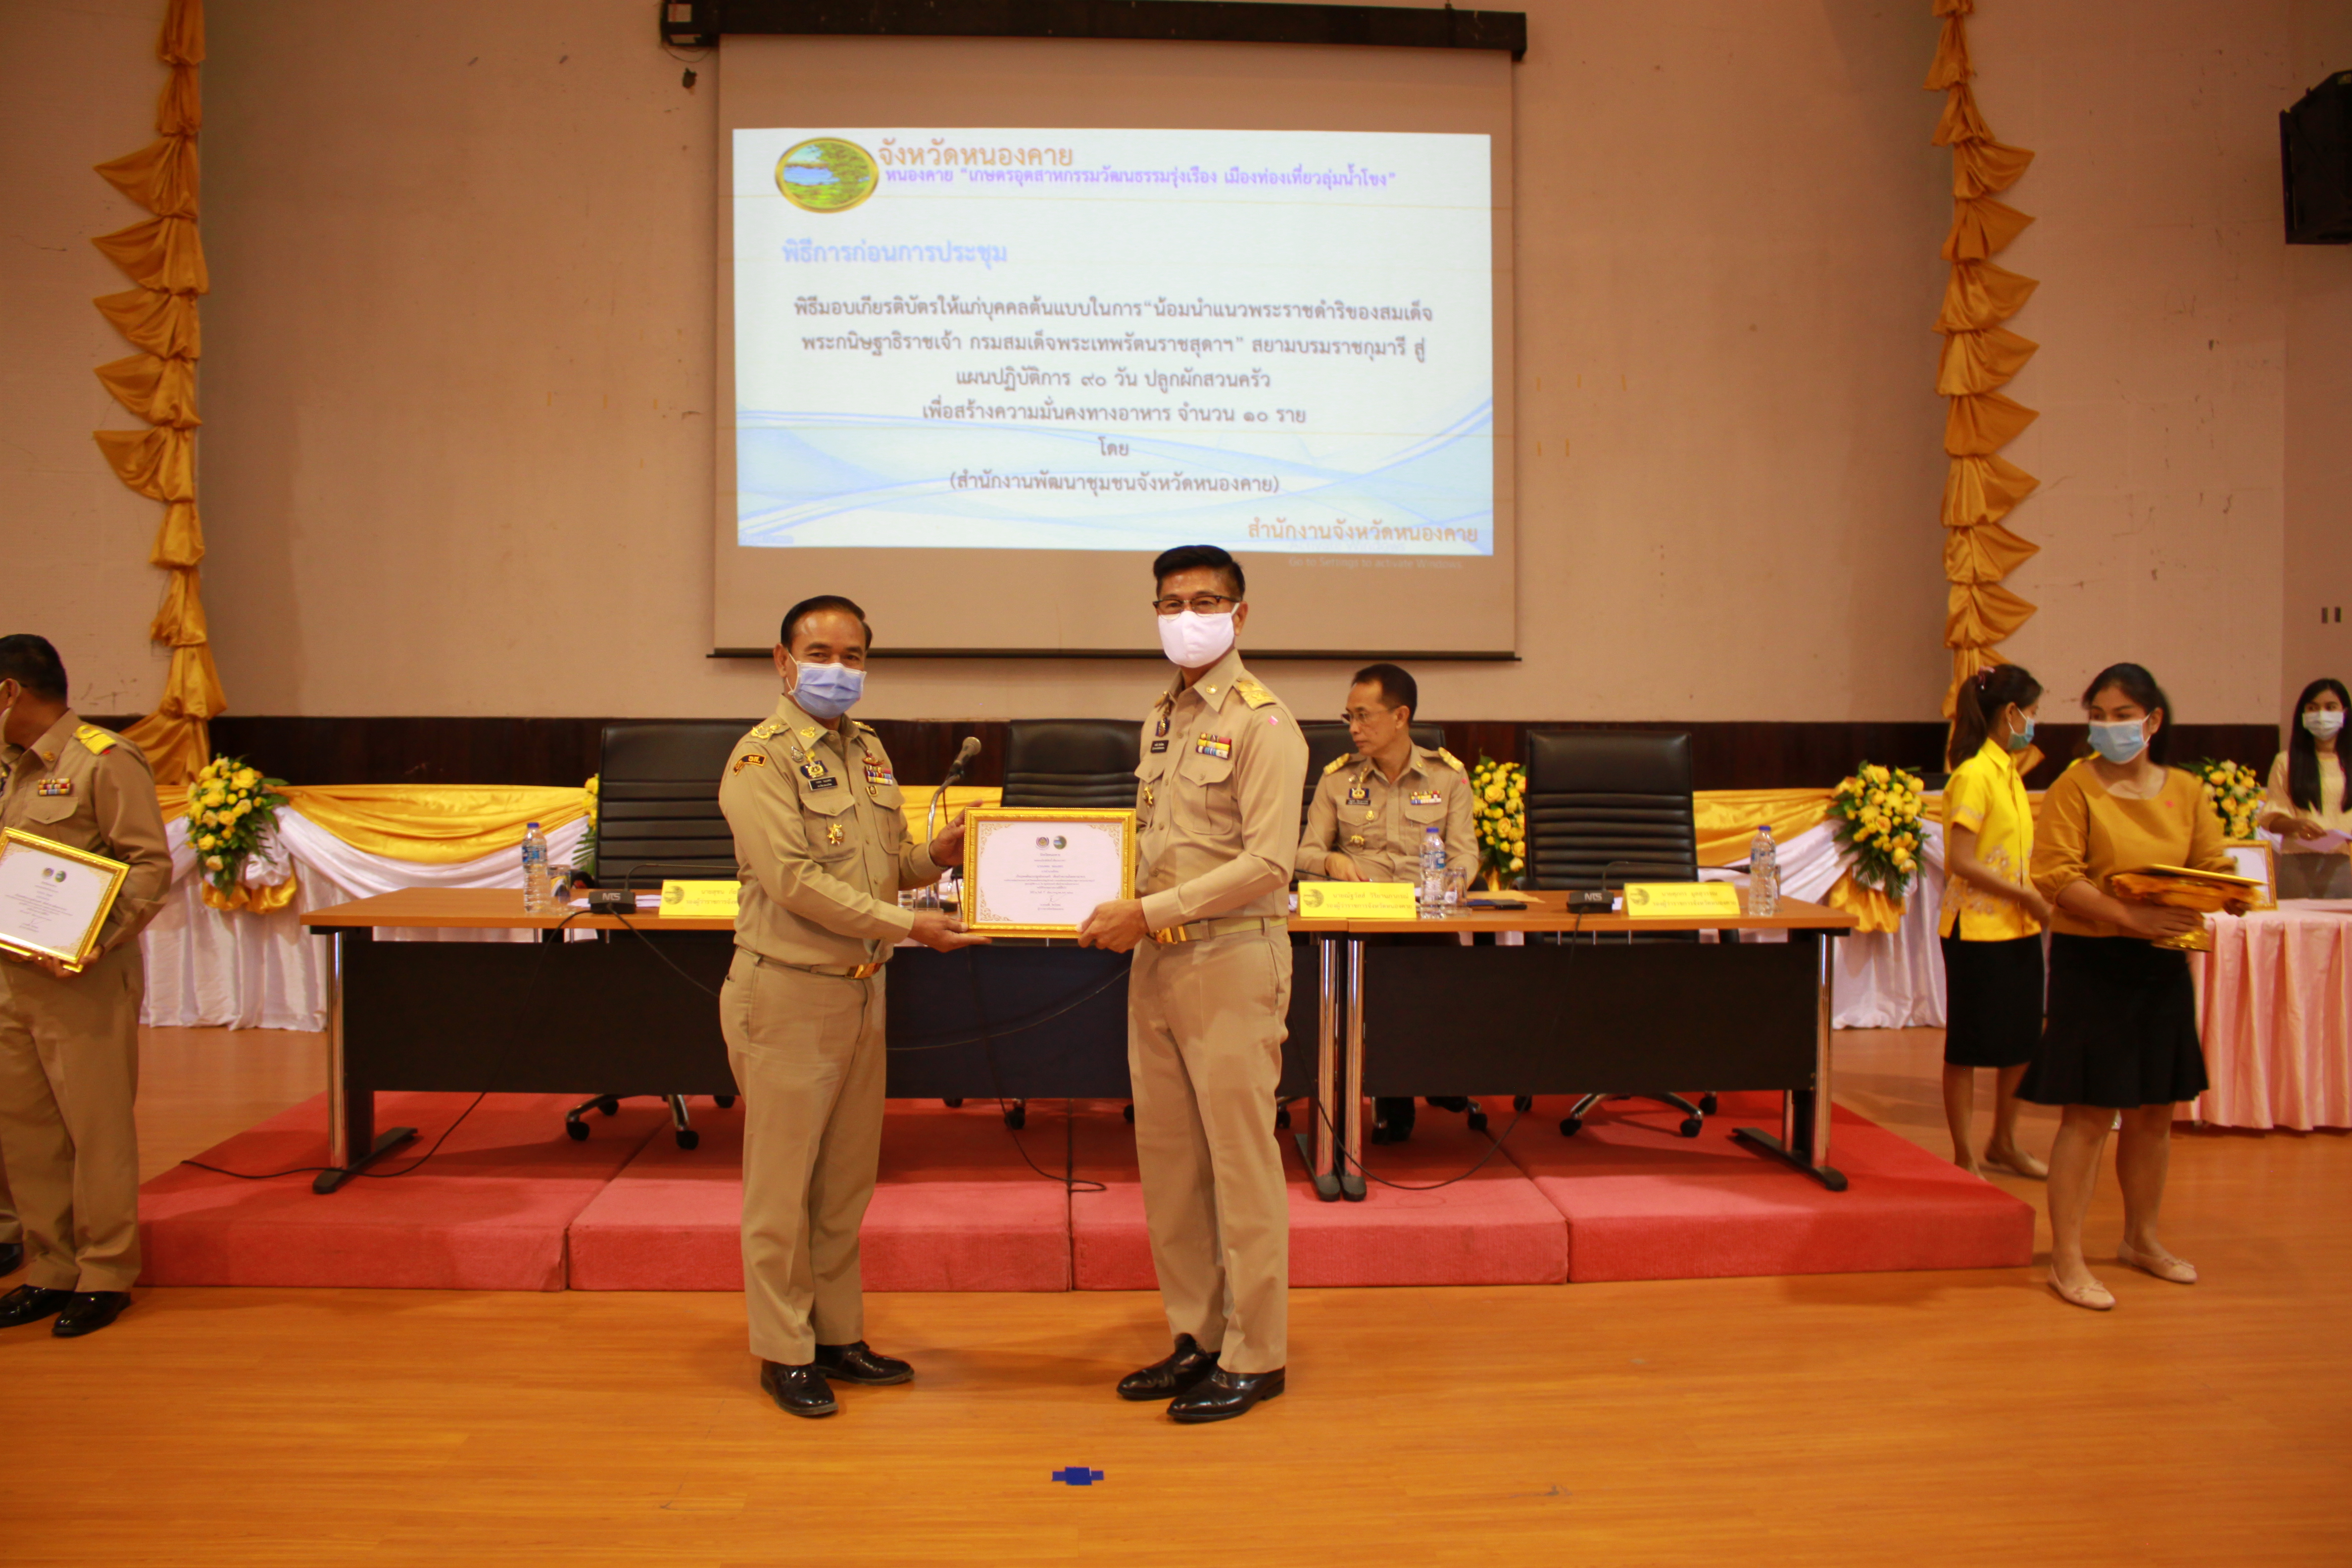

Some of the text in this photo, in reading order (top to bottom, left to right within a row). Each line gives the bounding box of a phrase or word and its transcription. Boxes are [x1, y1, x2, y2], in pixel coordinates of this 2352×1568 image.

[878, 138, 1073, 166] จังหวัดหนองคาย
[885, 169, 953, 182] หนองคาย
[782, 238, 1007, 270] พิธีการก่อนการประชุม
[802, 330, 961, 355] พระกนิษฐาธิราชเจ้า
[1252, 336, 1406, 360] สยามบรมราชกุมารี
[1414, 338, 1426, 363] สู่
[956, 365, 1271, 393] แผนปฏิบัติการ ๙๐ วัน ปลูกผักสวนครัว
[923, 395, 1307, 423] เพื่อสร้างความมั่นคงทางอาหาร จำนวน ๑๐ ราย
[1098, 437, 1129, 457] โดย
[949, 469, 1280, 496] (สำนักงานพัฒนาชุมชนจังหวัดหนองคาย)
[1248, 517, 1478, 543] สำนักงานจังหวัดหนองคาย
[1289, 556, 1304, 567] Go
[1306, 557, 1317, 567] to
[1320, 557, 1359, 570] Settings
[1362, 558, 1372, 568] to
[1375, 558, 1414, 569] activate
[602, 892, 621, 901] NTS
[1584, 892, 1603, 901] NTS
